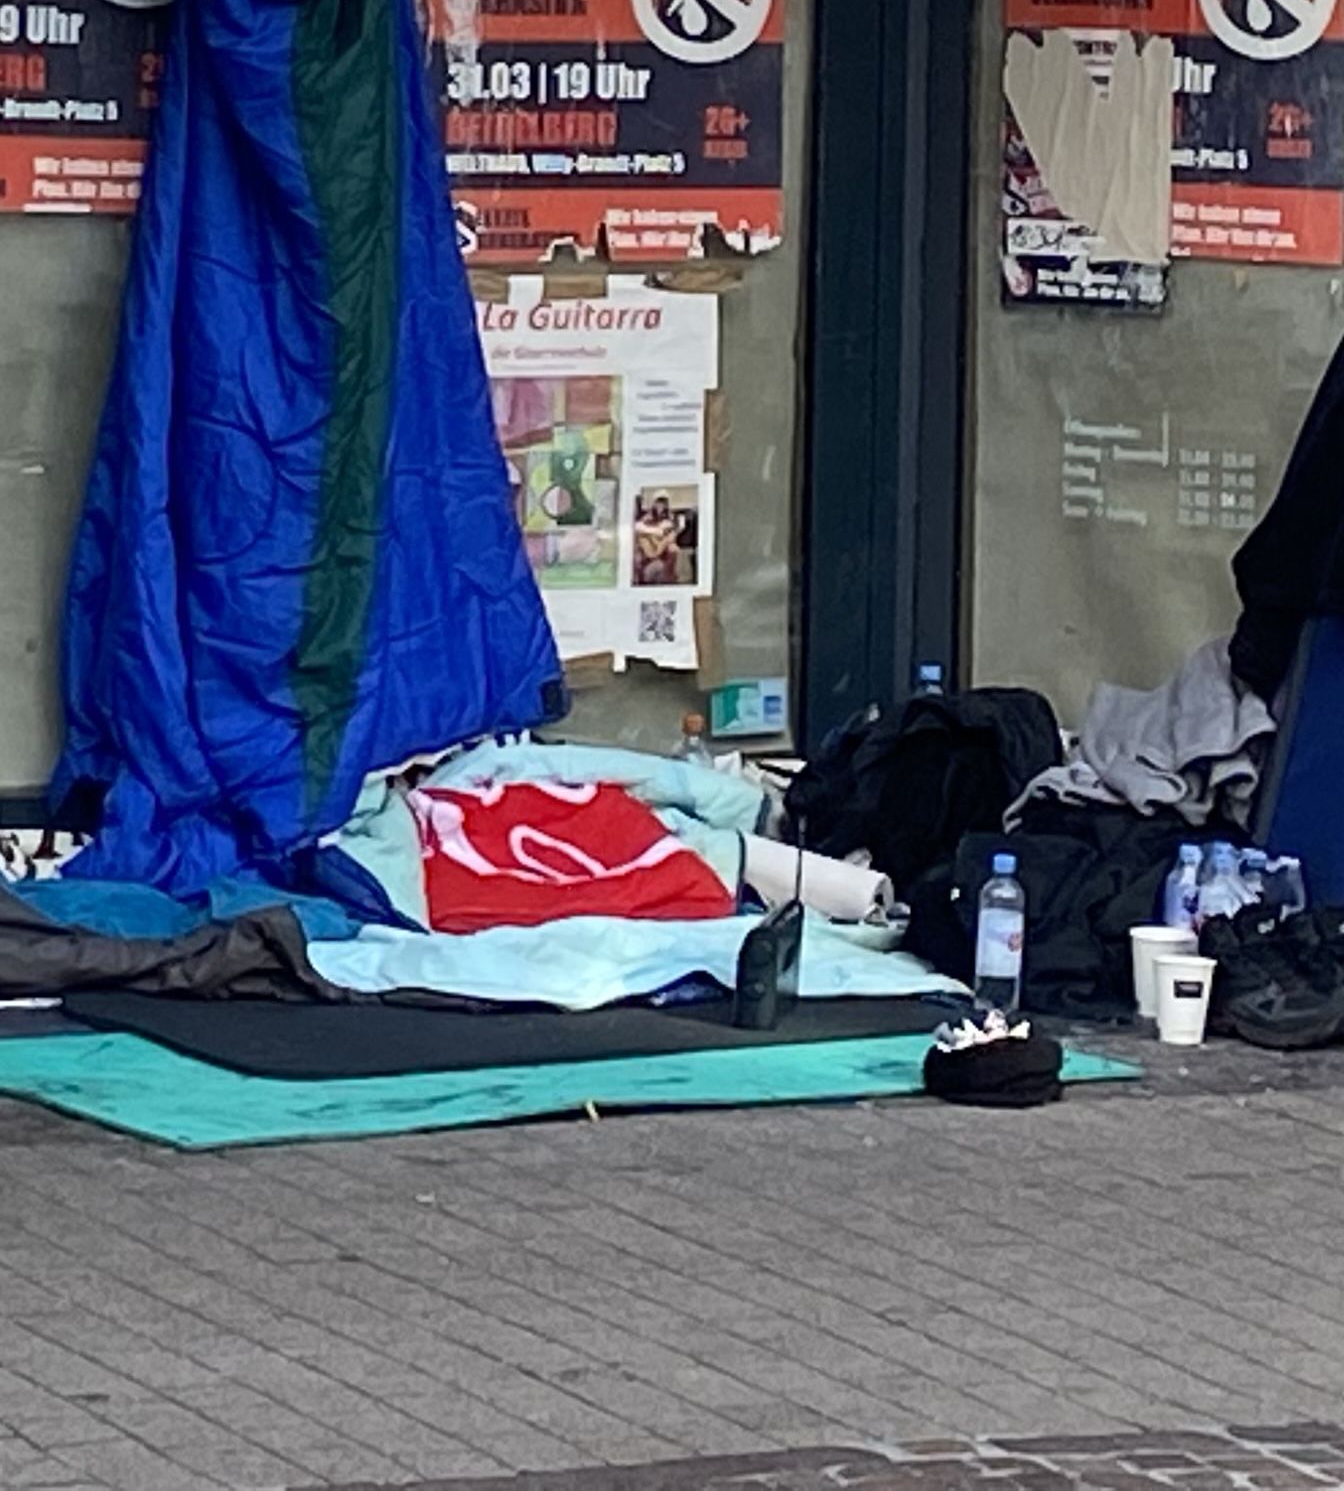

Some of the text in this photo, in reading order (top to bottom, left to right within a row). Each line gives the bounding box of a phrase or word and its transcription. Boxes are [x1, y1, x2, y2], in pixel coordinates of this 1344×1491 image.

[26, 5, 85, 44] Uhr
[554, 62, 589, 98] 19
[596, 61, 650, 101] Uhr
[484, 301, 662, 330] La Guitarra
